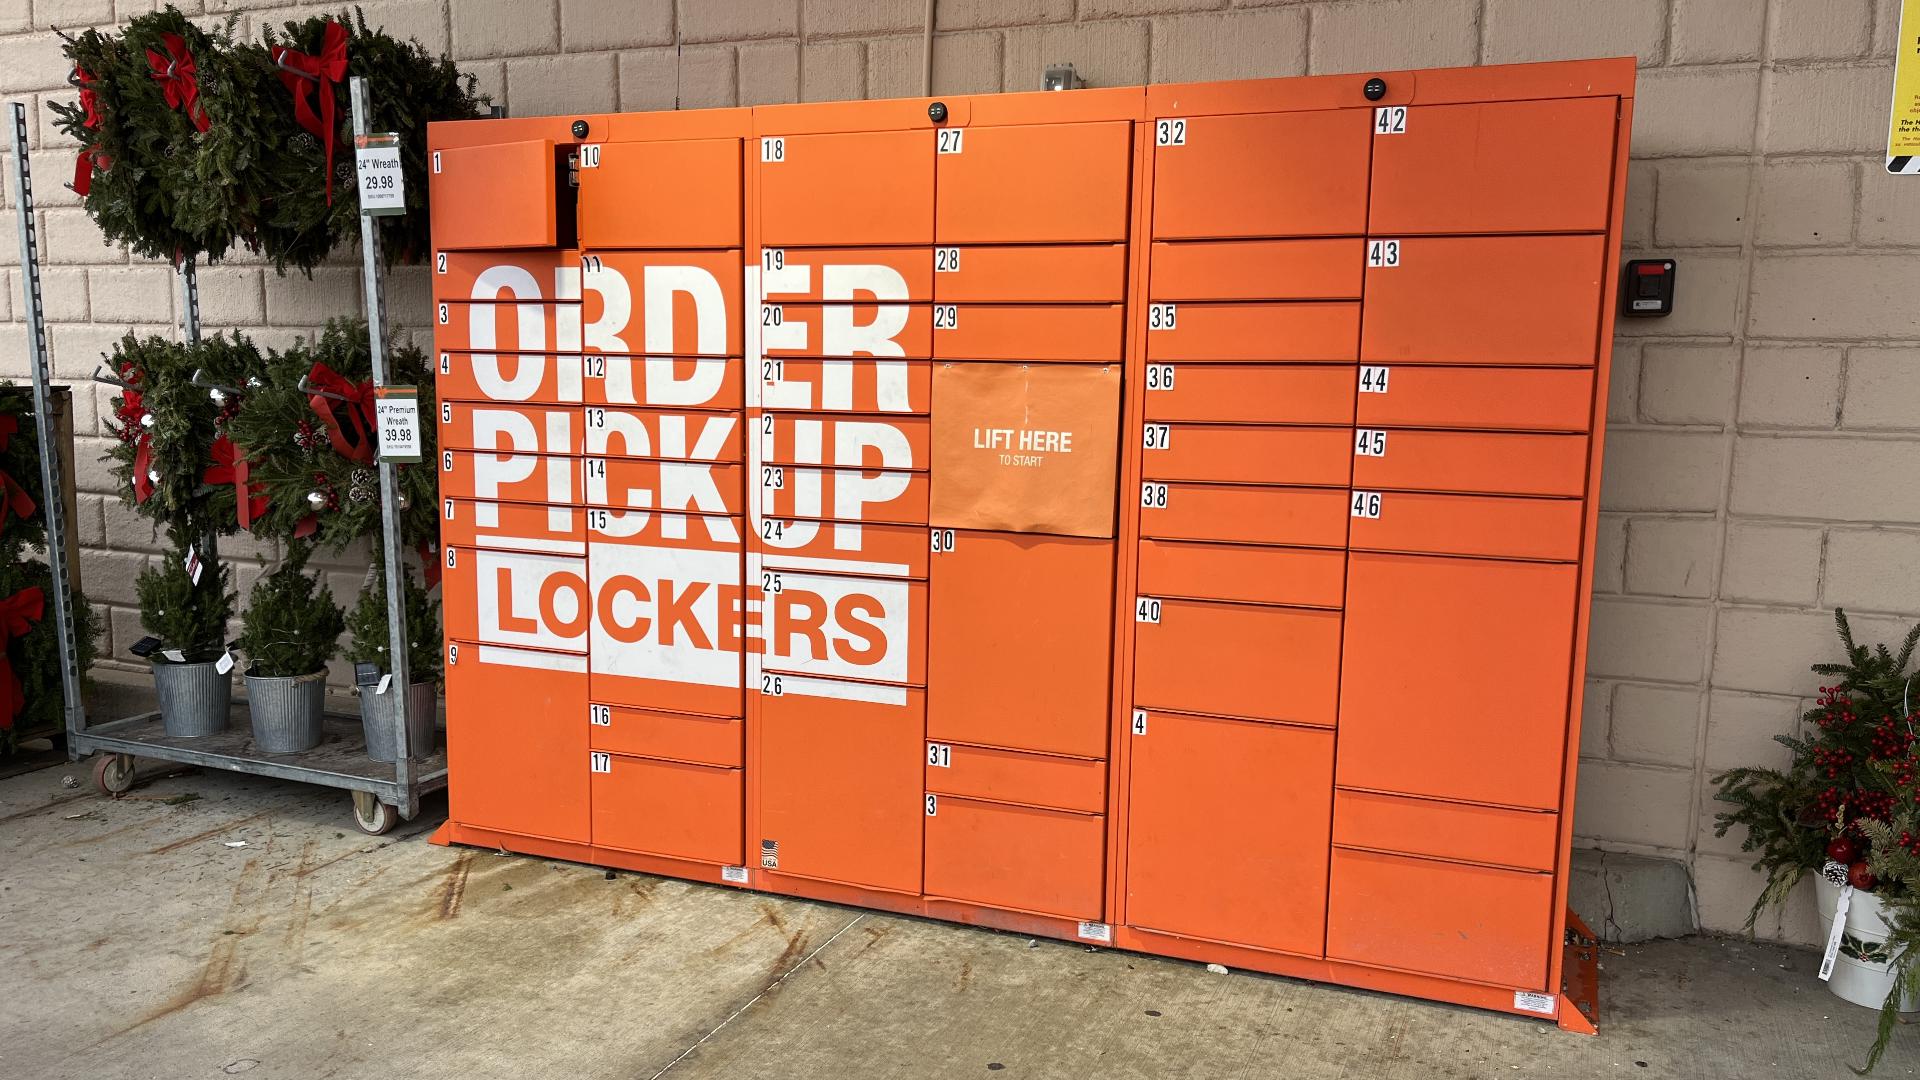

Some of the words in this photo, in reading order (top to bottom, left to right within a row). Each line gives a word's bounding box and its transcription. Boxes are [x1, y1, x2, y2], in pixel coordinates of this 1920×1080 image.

[1378, 108, 1405, 133] 42
[940, 130, 961, 152] 27
[1159, 121, 1184, 144] 32
[583, 146, 599, 166] 10
[764, 139, 783, 160] 18
[371, 158, 399, 168] Wreath
[434, 153, 440, 172] 1
[365, 175, 394, 189] 29.98
[438, 254, 446, 273] 2
[764, 250, 783, 271] 19
[937, 249, 958, 271] 28
[1370, 241, 1398, 266] 43
[440, 305, 448, 323] 3
[763, 306, 782, 327] 20
[935, 306, 956, 328] 29
[1151, 306, 1175, 328] 35
[470, 265, 913, 412] ORDER
[441, 355, 449, 373] 4
[586, 357, 603, 377] 12
[763, 361, 782, 381] 21
[1149, 366, 1173, 388] 36
[1361, 368, 1386, 392] 44
[389, 406, 415, 414] Premium
[443, 404, 450, 422] 5
[587, 409, 604, 428] 13
[386, 417, 408, 426] Wreath
[385, 429, 412, 441] 39.98
[974, 428, 1014, 450] LIFT
[1019, 430, 1072, 453] HERE
[1145, 426, 1168, 448] 37
[1358, 431, 1385, 455] 45
[444, 452, 452, 470] 6
[588, 459, 605, 479] 14
[999, 454, 1010, 466] TO
[1012, 455, 1043, 468] START
[472, 409, 913, 551] PICKUP
[764, 468, 783, 488] 23
[1143, 485, 1166, 507] 38
[1353, 493, 1380, 517] 46
[445, 501, 453, 518] 7
[589, 510, 606, 529] 15
[764, 520, 783, 540] 24
[933, 530, 953, 551] 30
[448, 549, 455, 567] 8
[763, 573, 782, 593] 25
[496, 567, 888, 665] LOCKERS
[1138, 600, 1160, 621] 40
[450, 647, 457, 663] 9
[762, 675, 782, 695] 26
[592, 705, 609, 725] 16
[593, 753, 609, 772] 17
[929, 745, 948, 766] 31
